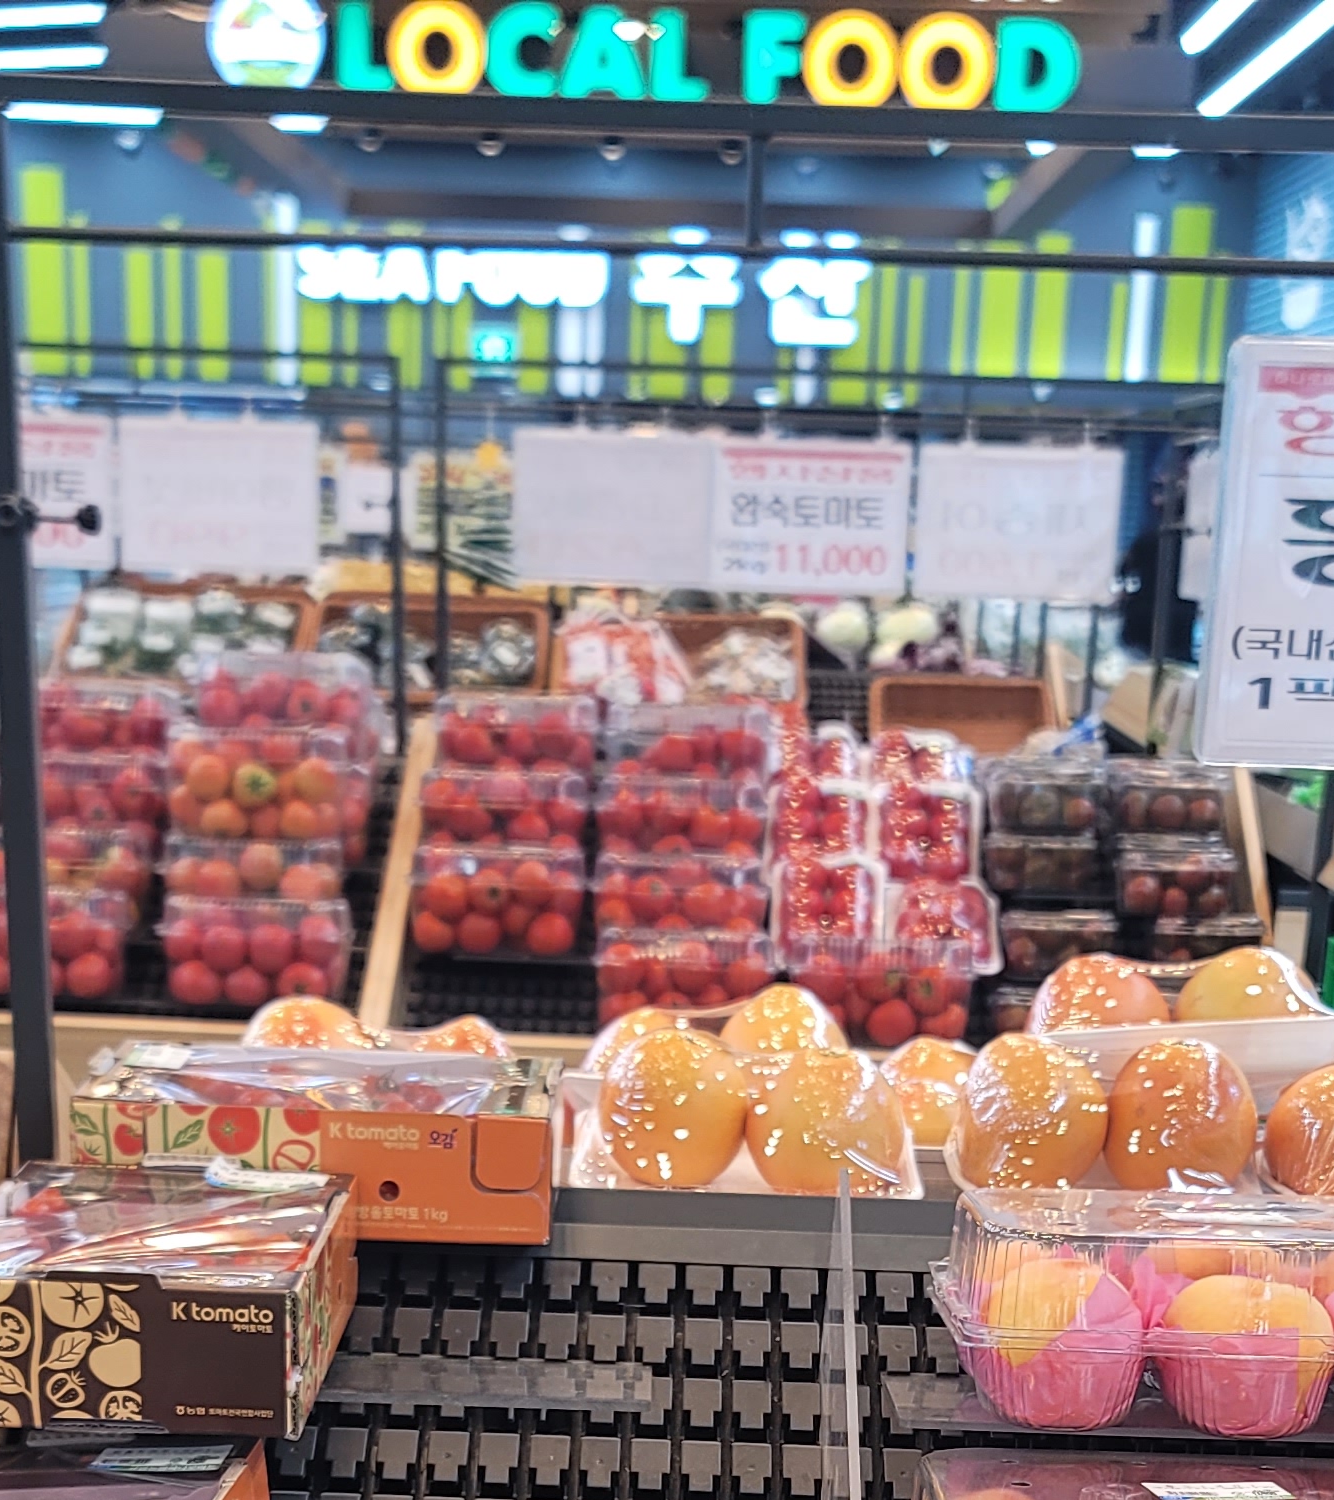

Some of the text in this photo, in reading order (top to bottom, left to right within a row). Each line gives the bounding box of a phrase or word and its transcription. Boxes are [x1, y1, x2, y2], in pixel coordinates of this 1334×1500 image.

[336, 0, 1080, 113] LOCAL FOOD
[329, 1123, 419, 1140] K tomato
[424, 1208, 448, 1222] 1kg
[172, 1302, 274, 1323] K tomato
